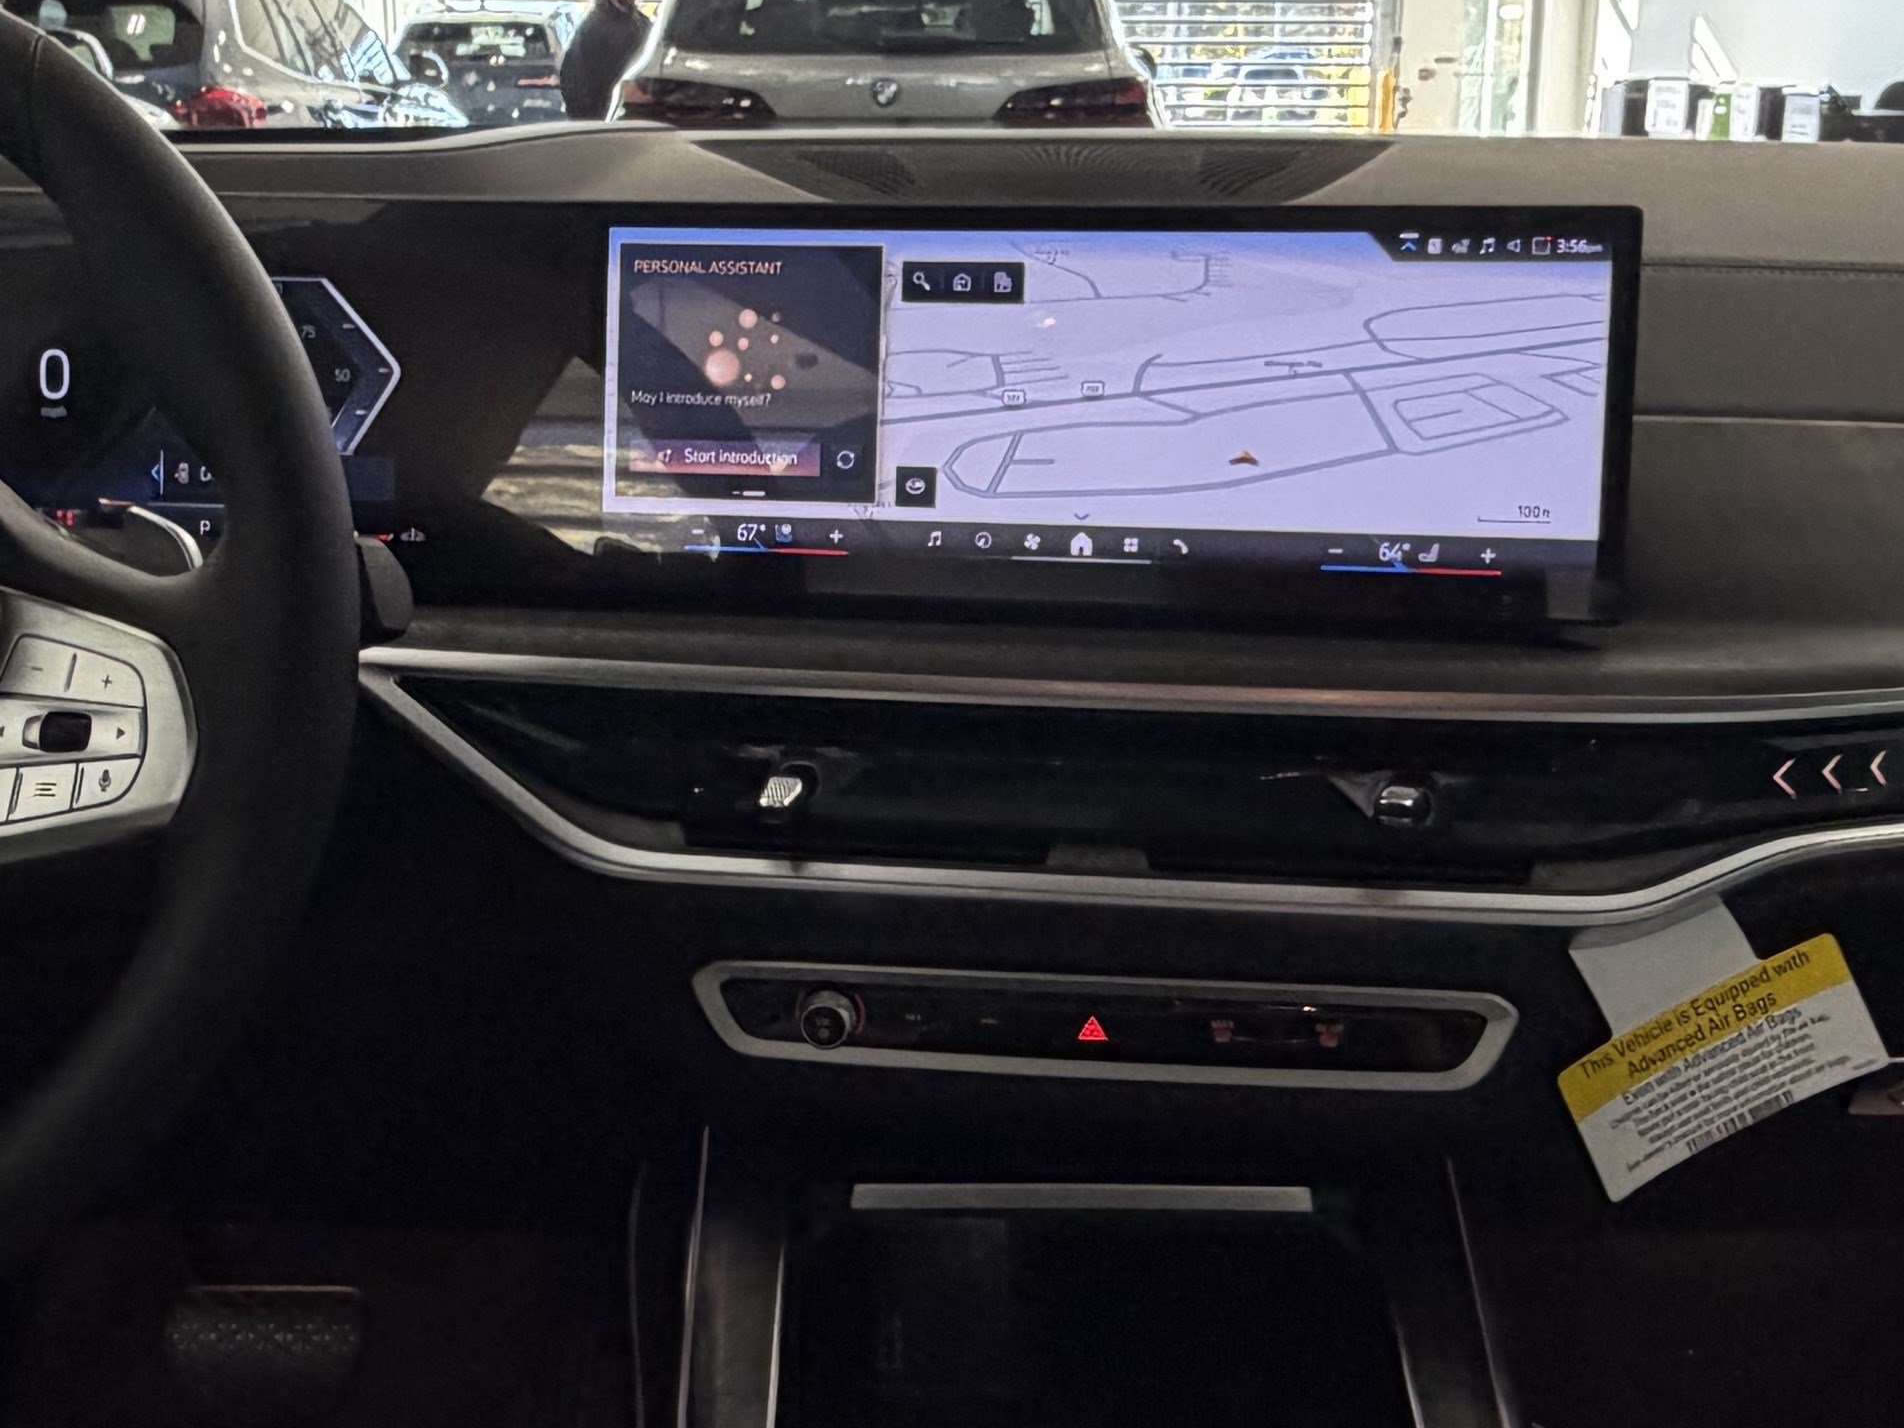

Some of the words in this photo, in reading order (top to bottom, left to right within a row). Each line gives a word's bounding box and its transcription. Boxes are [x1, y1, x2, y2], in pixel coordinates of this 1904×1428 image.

[633, 260, 705, 275] PERSONAL
[708, 261, 783, 275] ASSISTANT
[39, 348, 70, 400] 0
[334, 369, 351, 383] 50
[631, 390, 657, 406] May
[666, 392, 722, 405] introduce
[724, 392, 771, 407] myself?
[684, 448, 716, 464] Start
[719, 448, 798, 465] introduction
[199, 520, 212, 535] P
[1580, 1047, 1614, 1079] This
[1613, 1016, 1674, 1060] Vehicle
[1672, 1005, 1692, 1026] is
[1692, 969, 1771, 1018] Equipped
[1772, 949, 1810, 979] with
[1624, 1023, 1706, 1078] Advanced
[1705, 1009, 1733, 1035] Air
[1731, 989, 1778, 1021] Bags
[1681, 1029, 1746, 1072] Advanced
[1765, 1005, 1803, 1030] Bags
